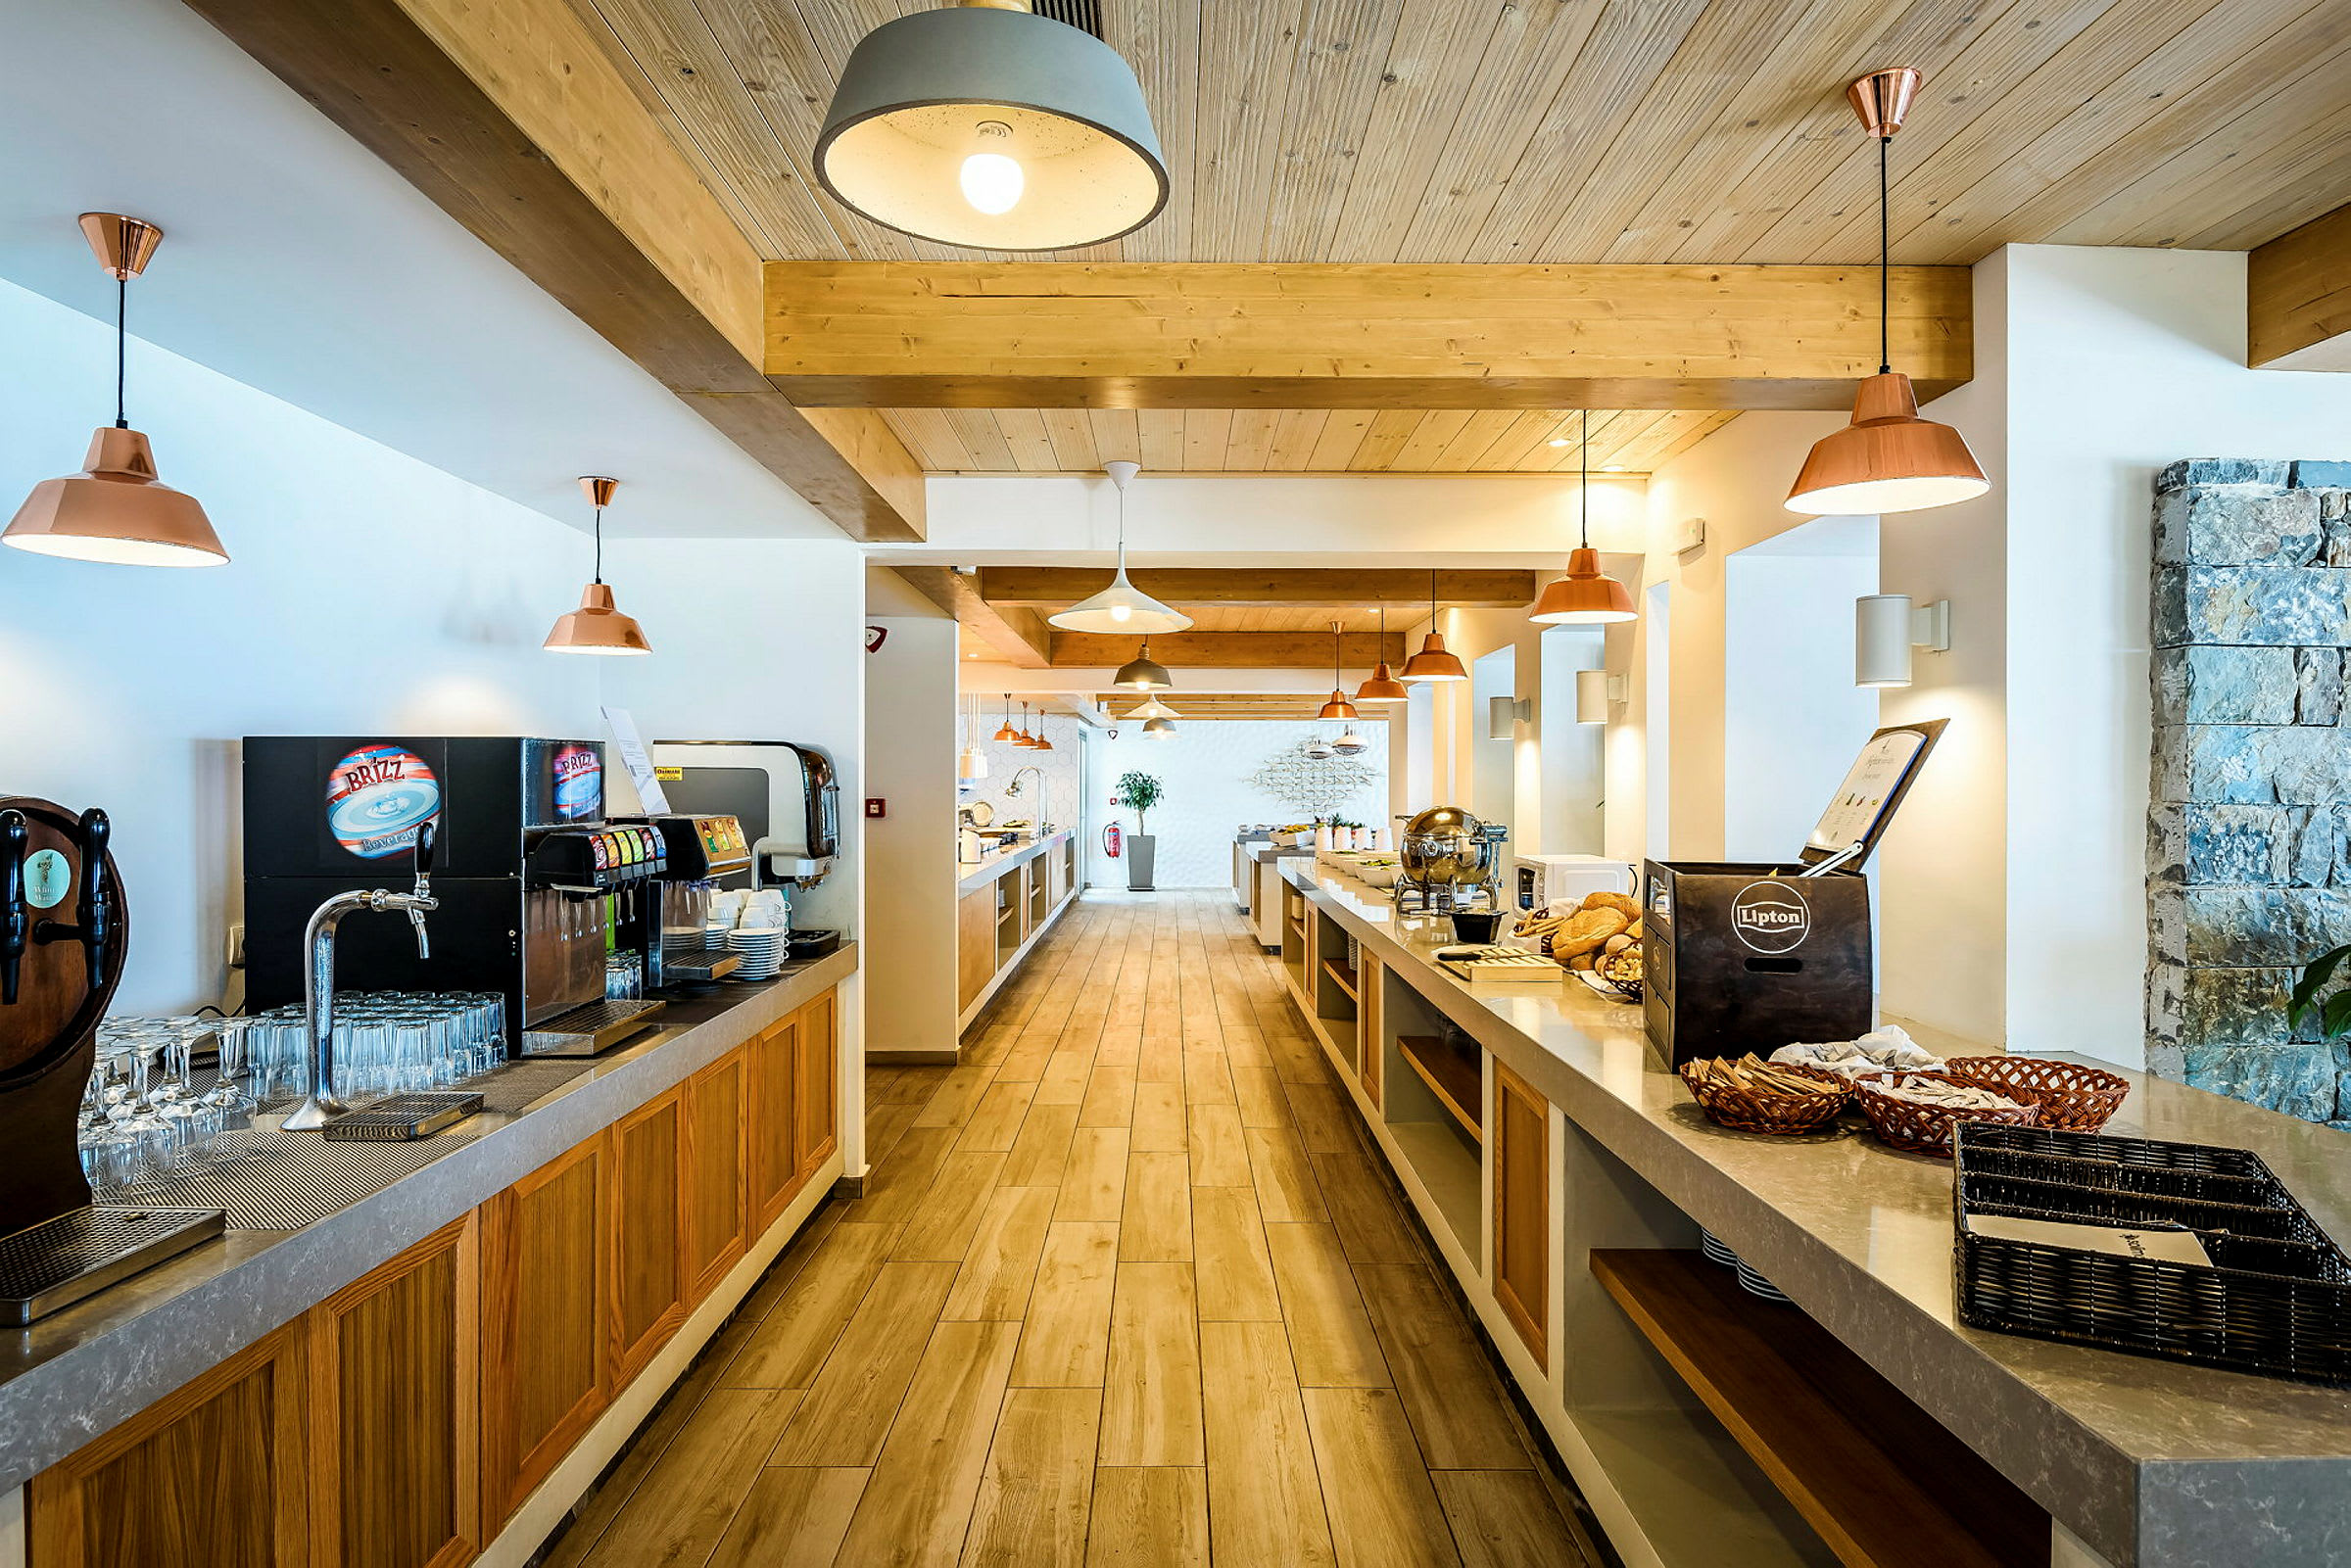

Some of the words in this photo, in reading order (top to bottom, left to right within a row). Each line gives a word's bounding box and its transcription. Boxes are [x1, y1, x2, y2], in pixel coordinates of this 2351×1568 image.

[346, 757, 406, 792] BRIZZ
[361, 828, 420, 851] Beverag
[1741, 909, 1800, 927] Lipton
